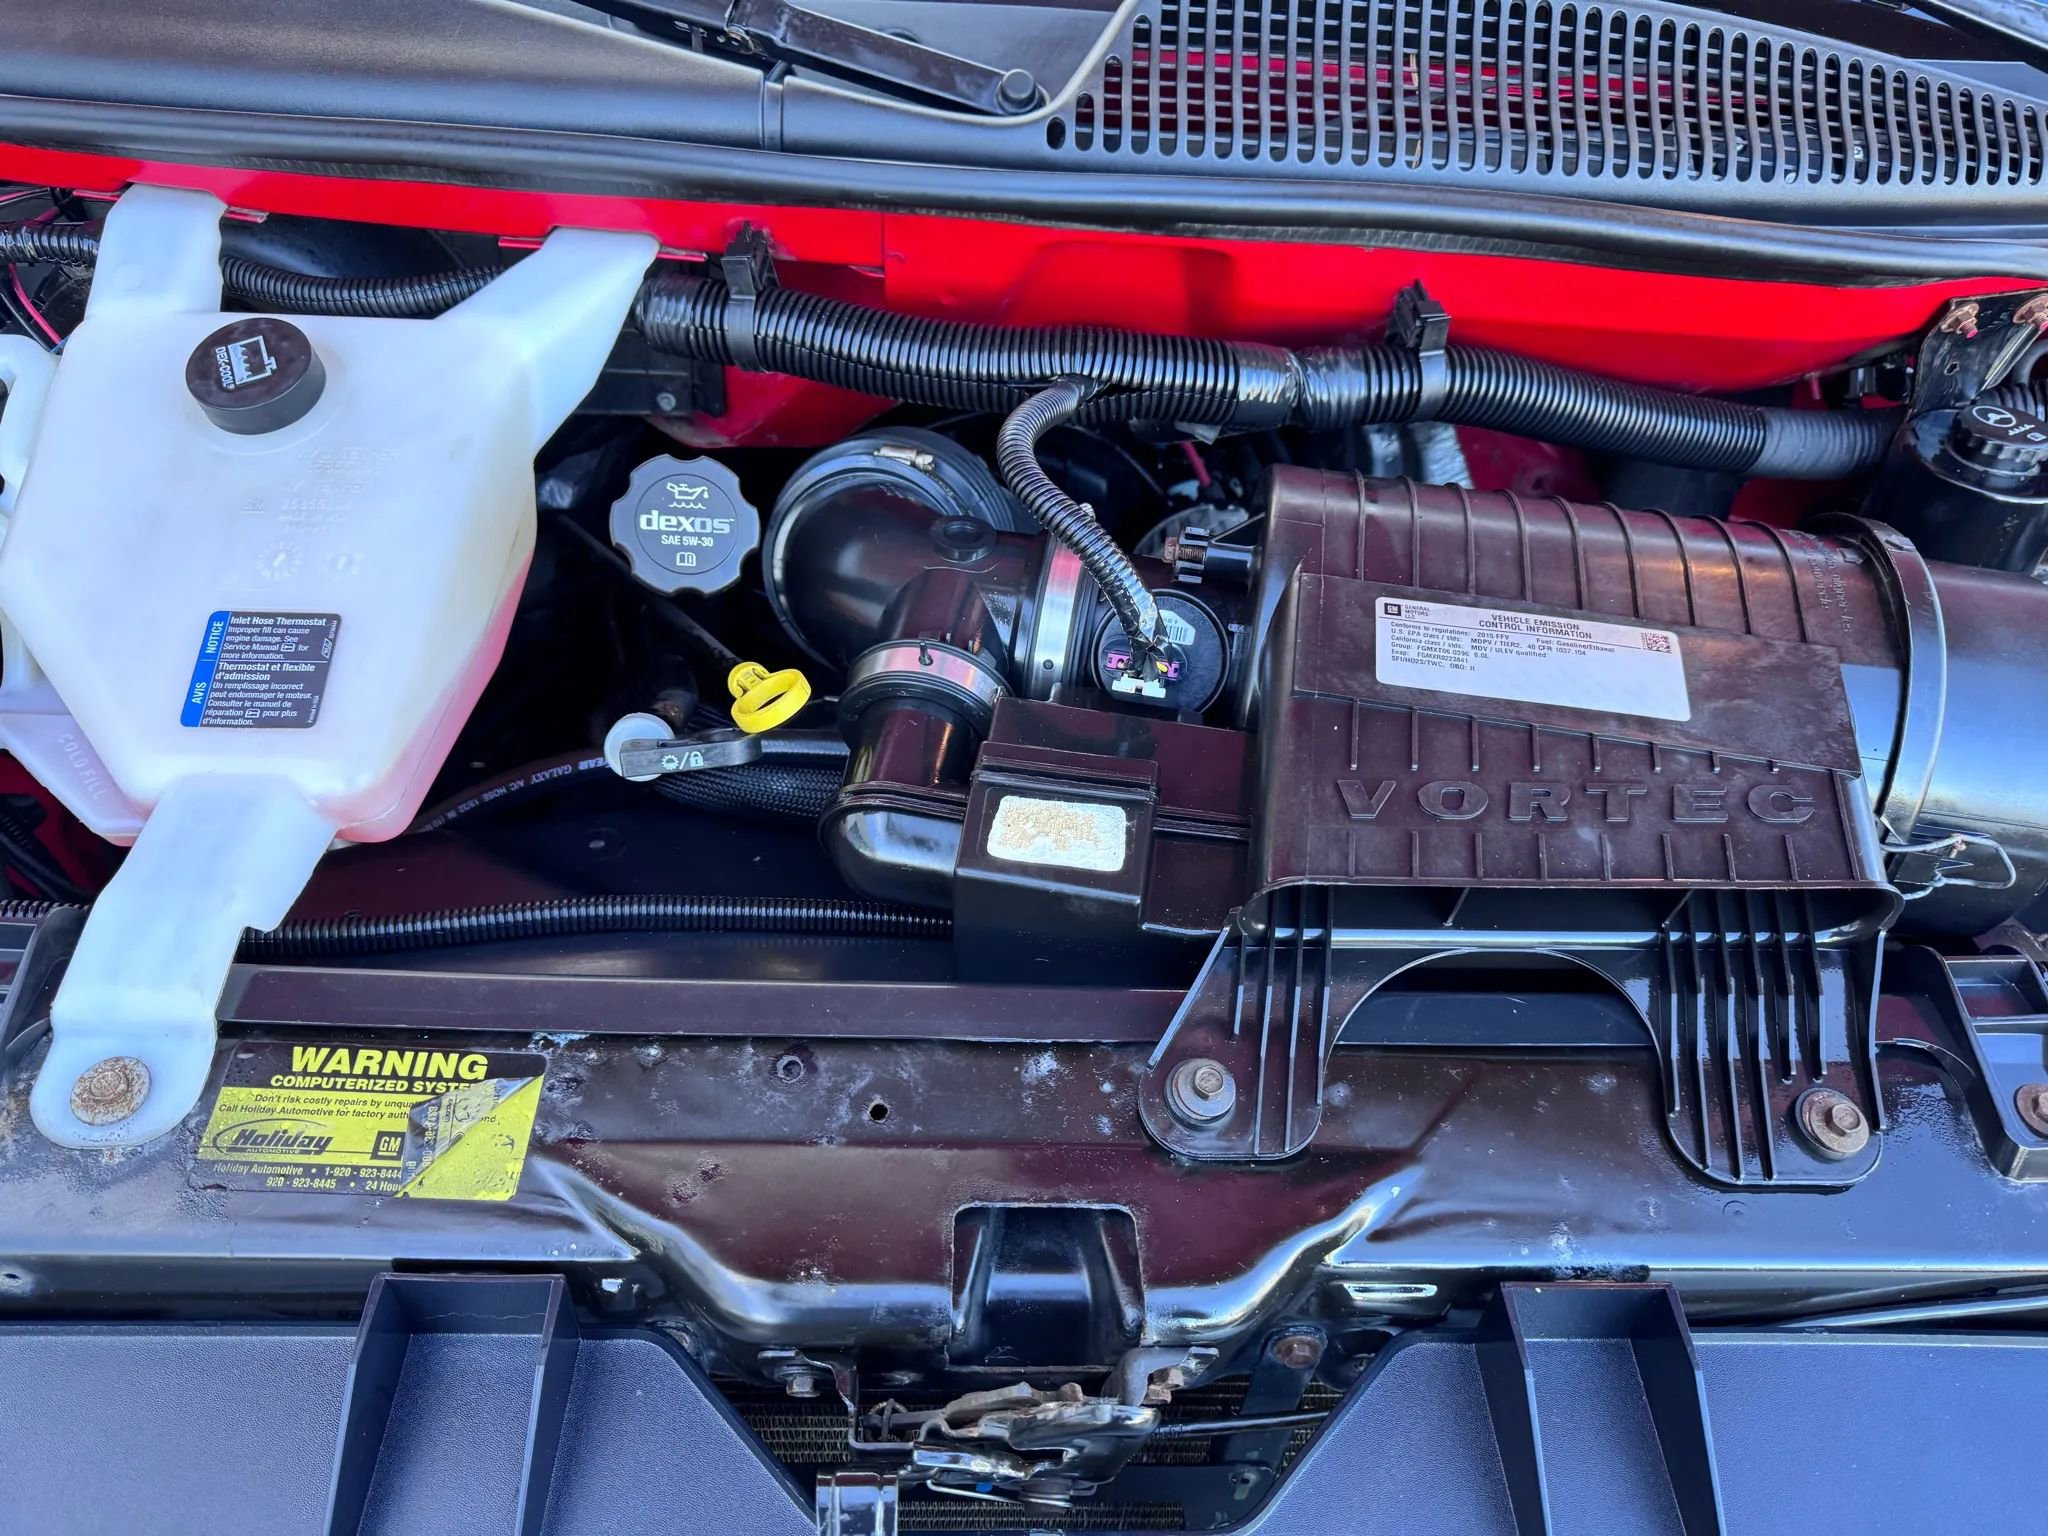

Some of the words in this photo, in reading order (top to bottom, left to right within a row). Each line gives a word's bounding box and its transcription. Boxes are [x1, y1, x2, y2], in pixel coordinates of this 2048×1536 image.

[640, 510, 731, 534] dexos
[661, 535, 681, 545] SAE
[683, 536, 713, 547] 5W-30
[230, 616, 251, 625] Inlet
[252, 617, 274, 626] Hose
[277, 617, 326, 626] Thermostat
[1491, 614, 1530, 625] VEHICLE
[1534, 619, 1579, 630] EMISSION
[228, 626, 261, 634] Improper
[1391, 621, 1421, 630] Conforms
[1432, 627, 1470, 636] regulations:
[1557, 640, 1615, 652] Gasoline/Ethanol
[1479, 620, 1523, 631] CONTROL
[1526, 625, 1592, 639] INFORMATION
[205, 621, 224, 653] NOTICE
[1391, 641, 1412, 649] Group:
[1391, 635, 1422, 643] California
[1516, 650, 1546, 658] qualified
[241, 652, 285, 660] information.
[218, 662, 269, 671] Thermostat
[271, 663, 281, 671] et
[282, 663, 315, 672] flexible
[215, 672, 271, 680] d'admission
[192, 682, 207, 704] AVIS
[222, 682, 269, 691] remplissage
[210, 691, 227, 699] peut
[228, 691, 276, 700] endommager
[208, 699, 243, 707] Consulter
[253, 700, 281, 708] manuel
[205, 708, 243, 717] réparation
[202, 717, 254, 725] d'information.
[530, 764, 573, 785] GALAXY
[482, 787, 507, 802] HOSE
[1337, 779, 1817, 823] VORTEC
[292, 1046, 488, 1080] WARNING
[270, 1075, 409, 1092] COMPUTERIZED
[255, 1094, 281, 1102] Don't
[283, 1096, 301, 1104] risk
[304, 1096, 332, 1106] costly
[334, 1098, 367, 1107] repairs
[370, 1099, 382, 1108] by
[219, 1104, 238, 1112] Call
[240, 1105, 277, 1115] Holiday
[278, 1106, 334, 1116] Automotive
[336, 1109, 351, 1117] for
[352, 1110, 386, 1120] factory
[231, 1128, 334, 1155] Holiday
[379, 1136, 401, 1152] GM
[214, 1162, 249, 1175] Holiday
[251, 1164, 303, 1175] Automotive
[325, 1166, 351, 1176] 1-920
[266, 1176, 284, 1187] 920
[292, 1177, 336, 1188] 923-8445
[365, 1180, 377, 1190] 24
